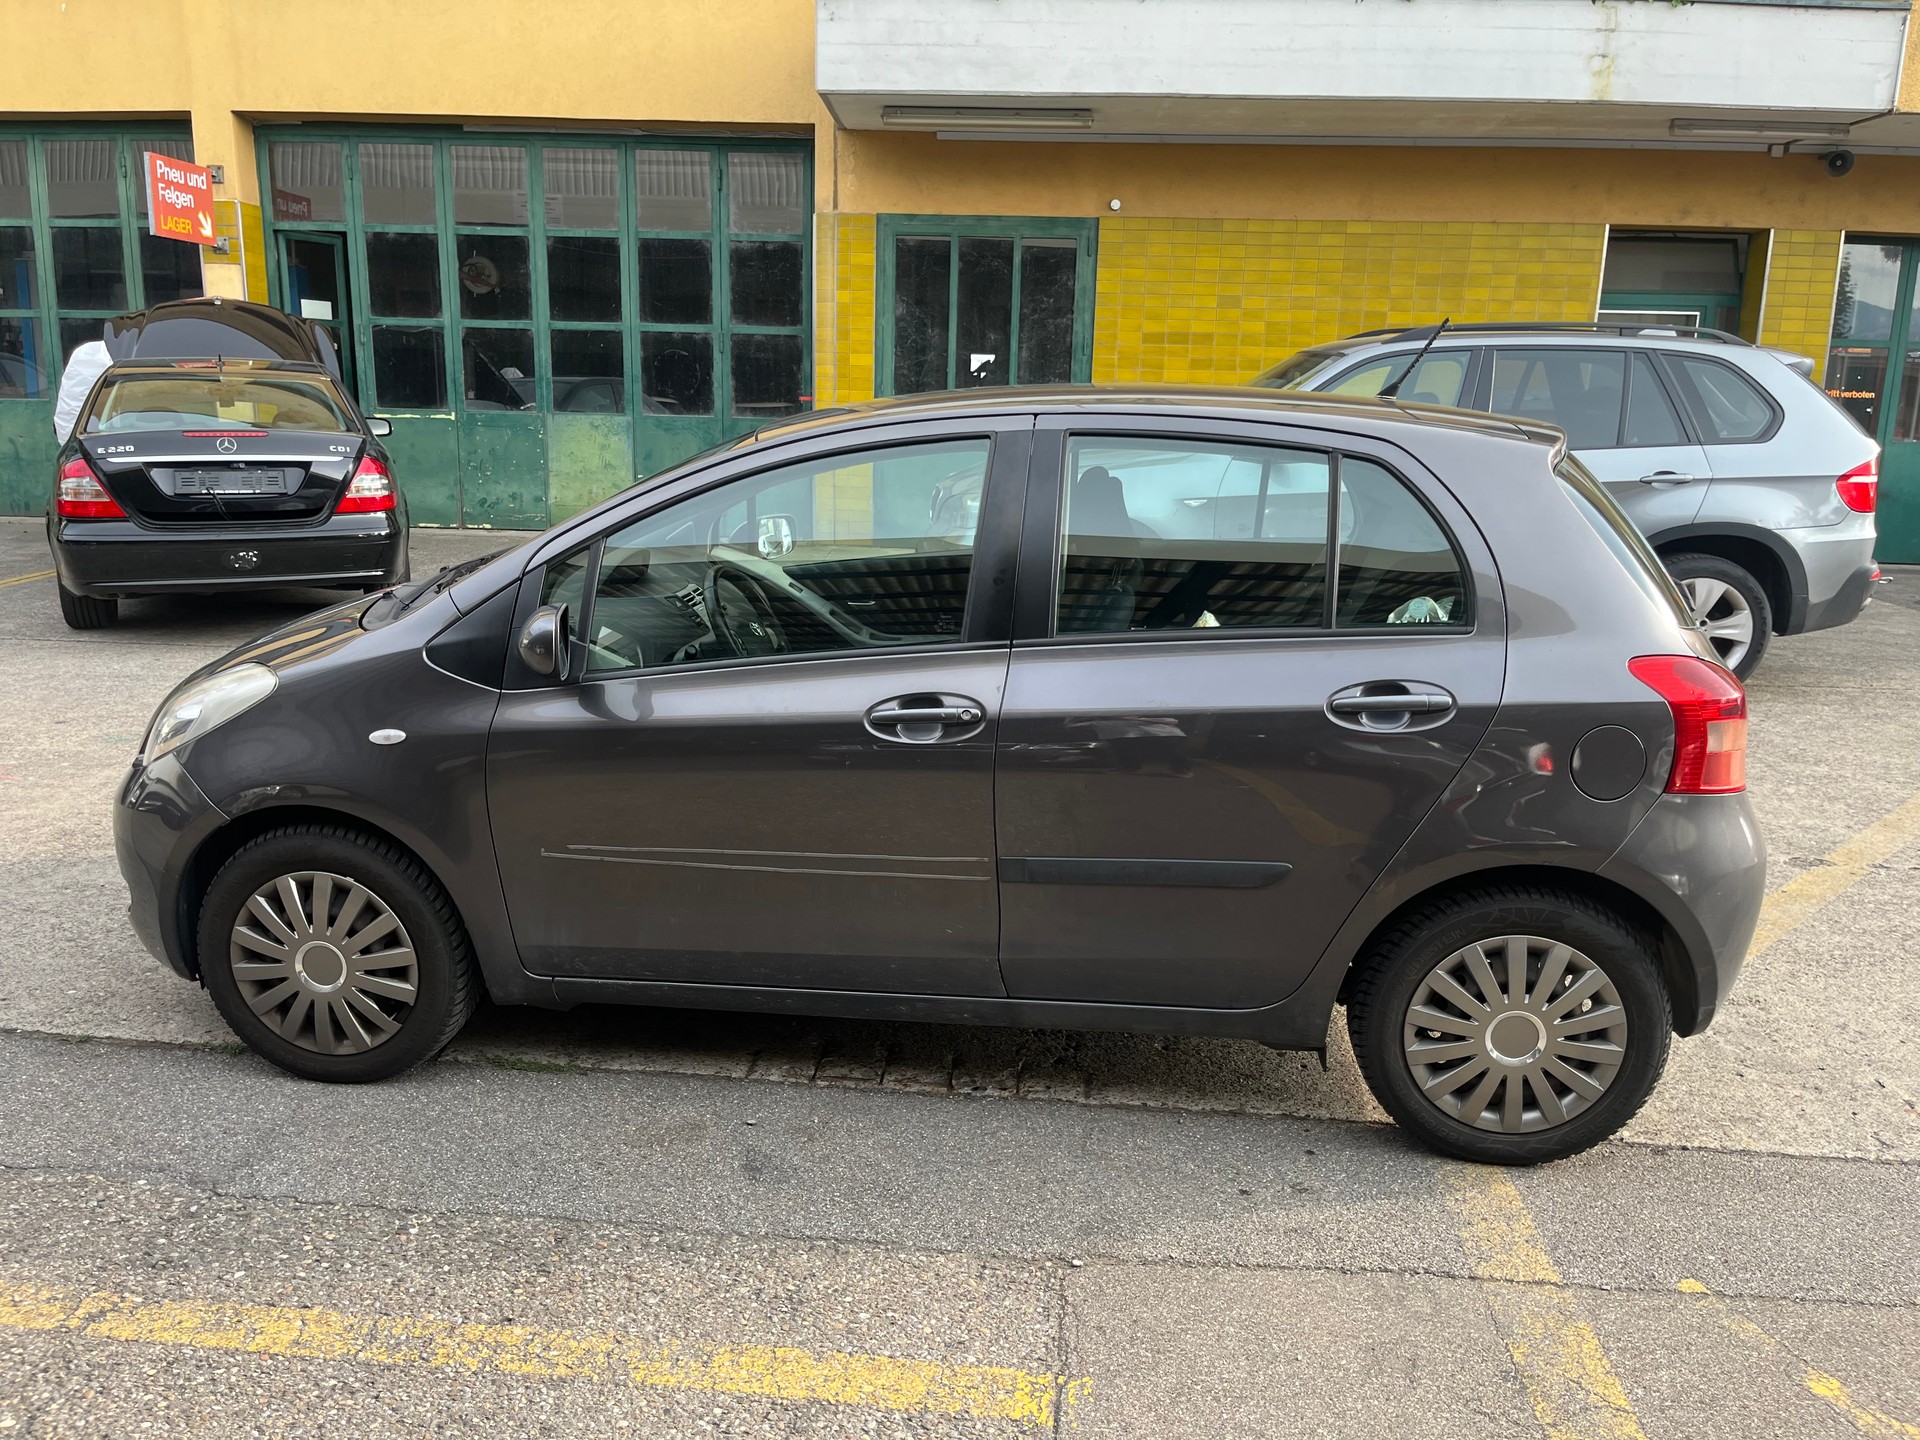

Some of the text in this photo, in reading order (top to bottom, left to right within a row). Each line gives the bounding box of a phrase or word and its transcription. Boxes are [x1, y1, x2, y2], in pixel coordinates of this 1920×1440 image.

[156, 160, 207, 190] Pneu und
[158, 182, 195, 209] Felgen
[160, 213, 193, 235] LAGER
[1840, 390, 1875, 399] verboten
[107, 445, 135, 453] 220
[329, 445, 350, 453] CDI
